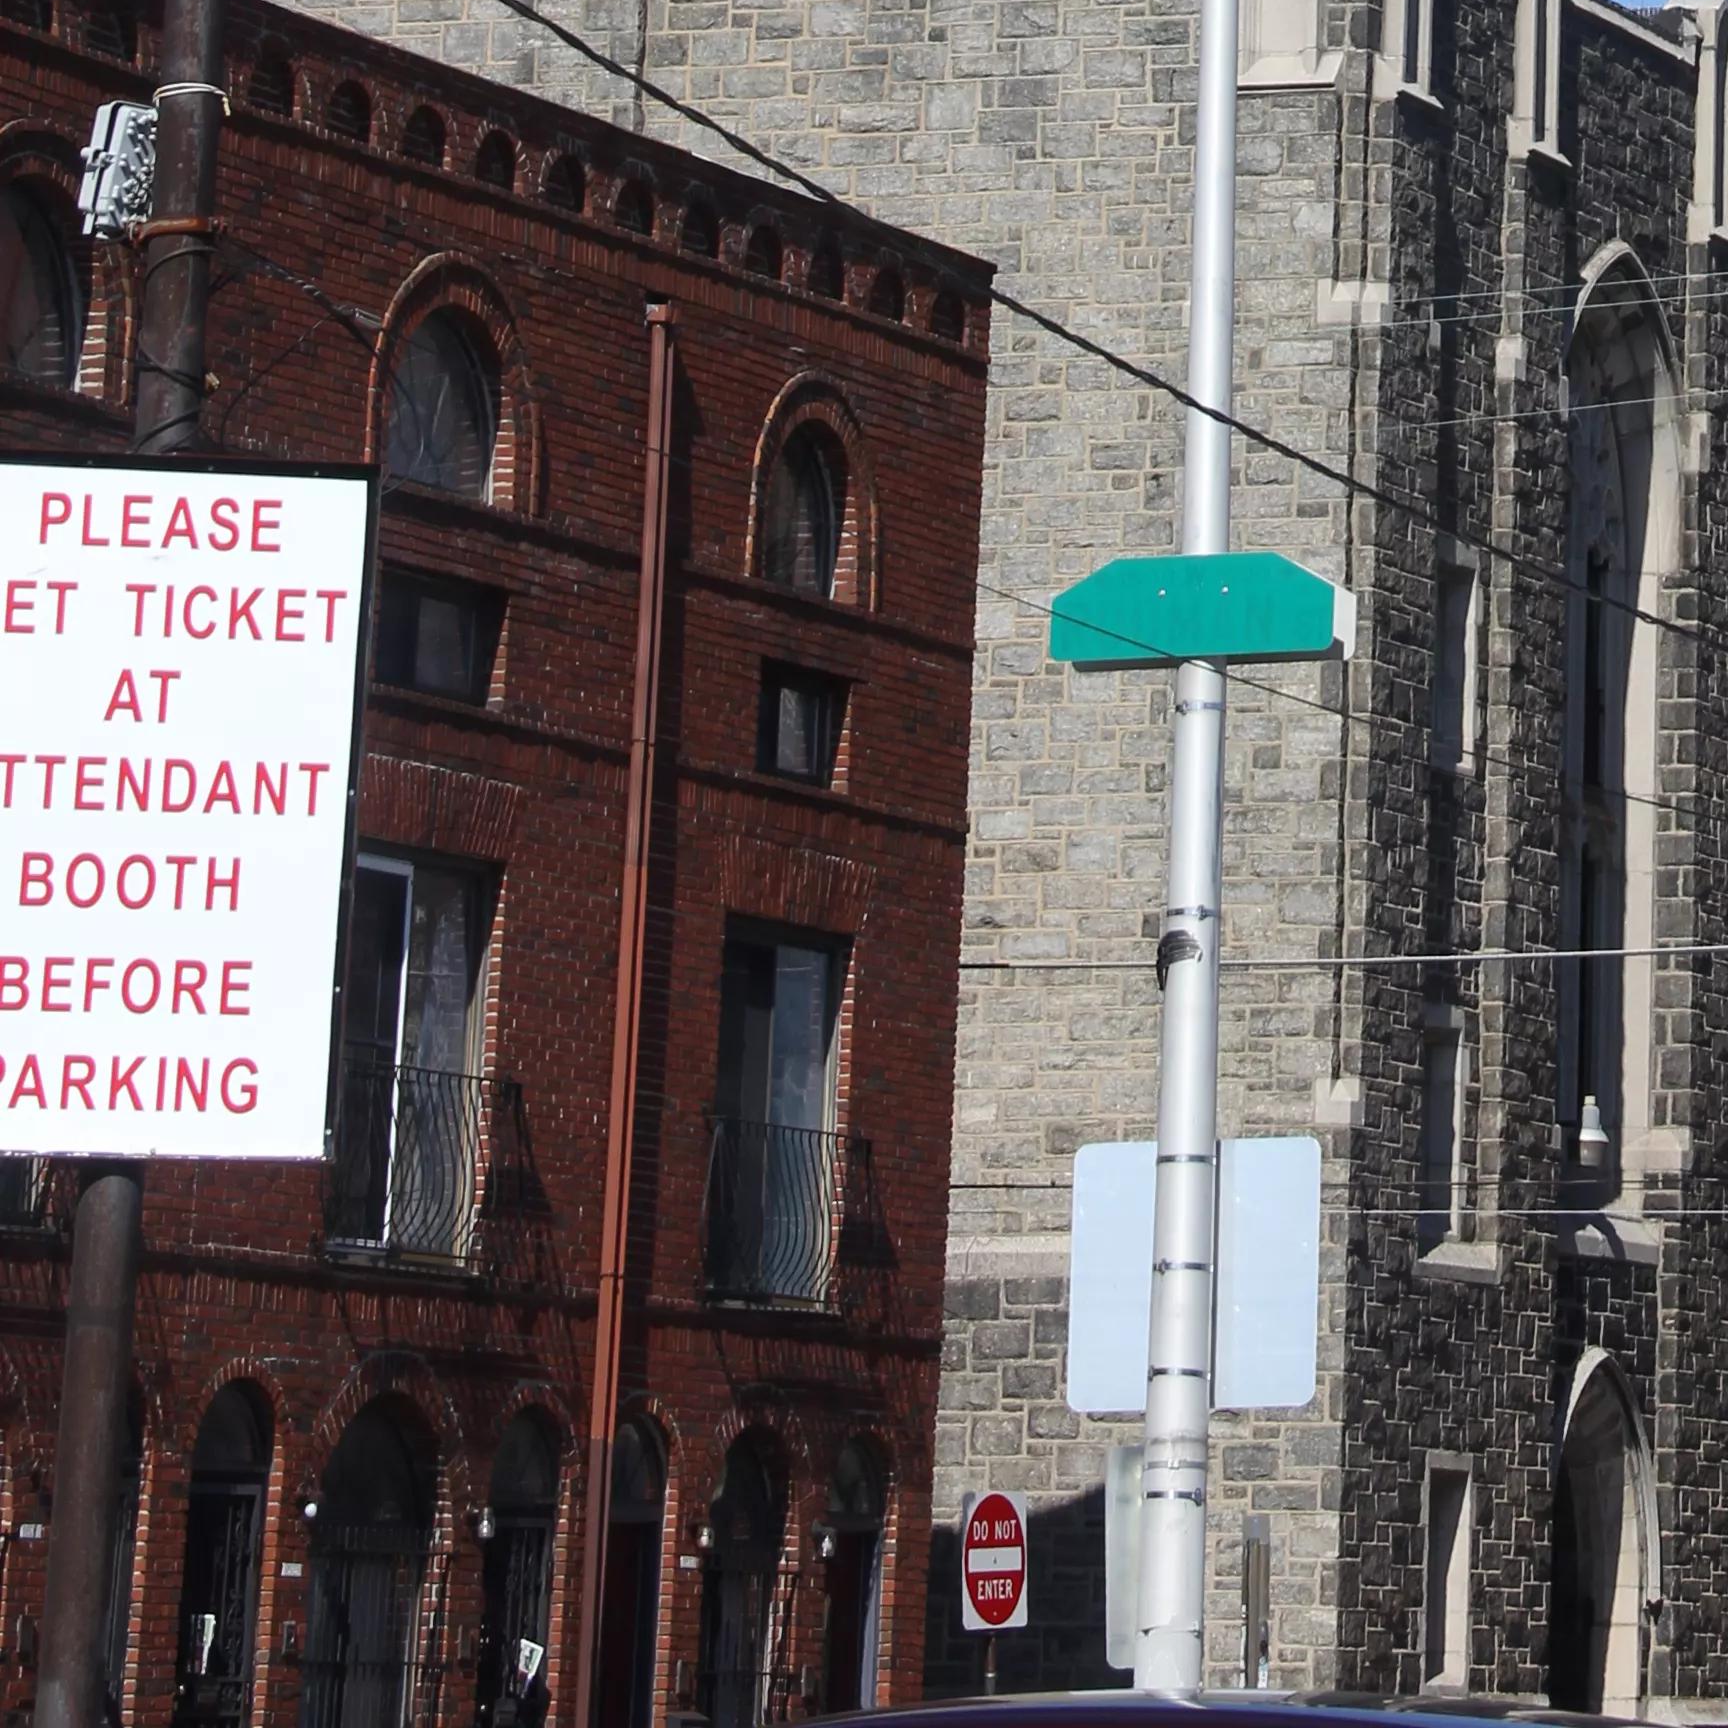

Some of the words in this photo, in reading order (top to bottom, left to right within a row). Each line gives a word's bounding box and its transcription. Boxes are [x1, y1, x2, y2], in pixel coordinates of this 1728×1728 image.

[39, 491, 283, 553] PLEASE
[126, 582, 349, 643] TICKET
[104, 668, 182, 723] AT
[18, 851, 242, 911] BOOTH
[0, 955, 253, 1016] BEFORE
[0, 1054, 259, 1114] ARKING
[972, 1520, 989, 1541] DO
[994, 1519, 1017, 1540] NOT
[977, 1579, 1013, 1600] ENTER
